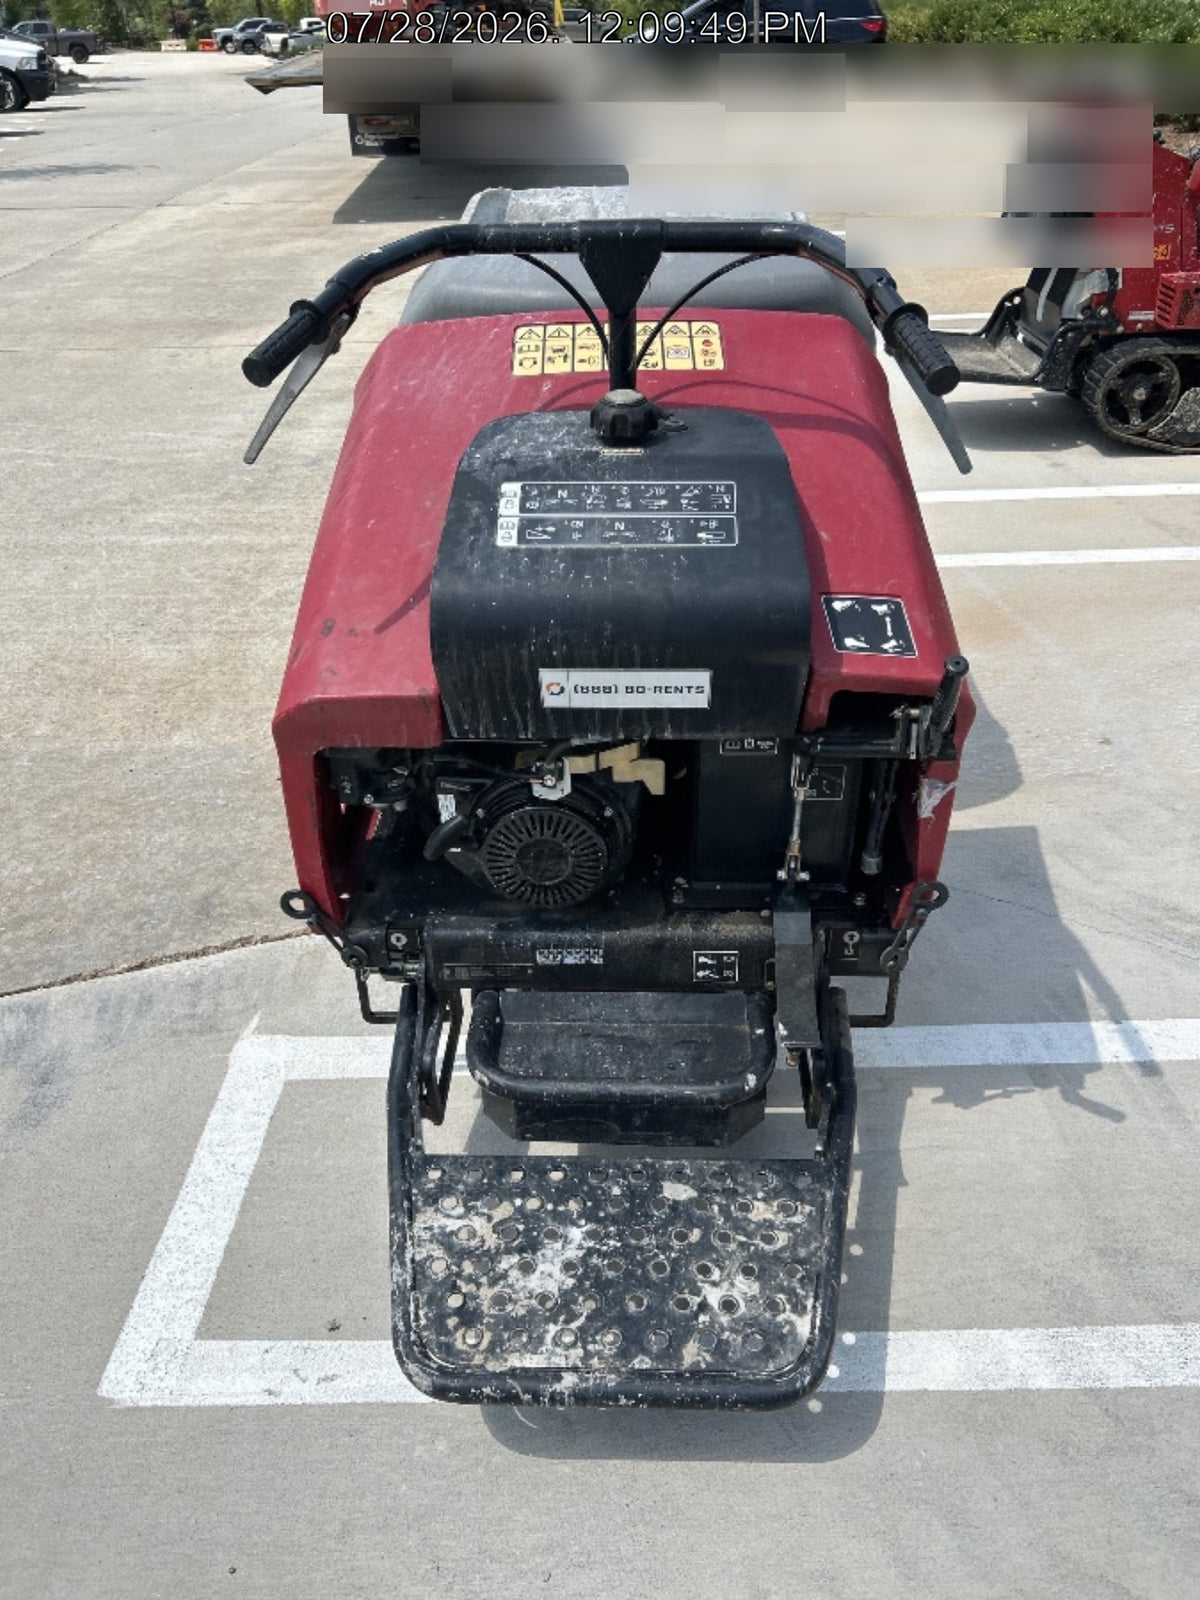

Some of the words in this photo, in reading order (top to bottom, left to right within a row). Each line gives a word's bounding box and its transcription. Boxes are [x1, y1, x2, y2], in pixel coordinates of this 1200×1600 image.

[557, 489, 568, 498] N
[614, 521, 625, 531] N
[573, 684, 618, 694] (888)
